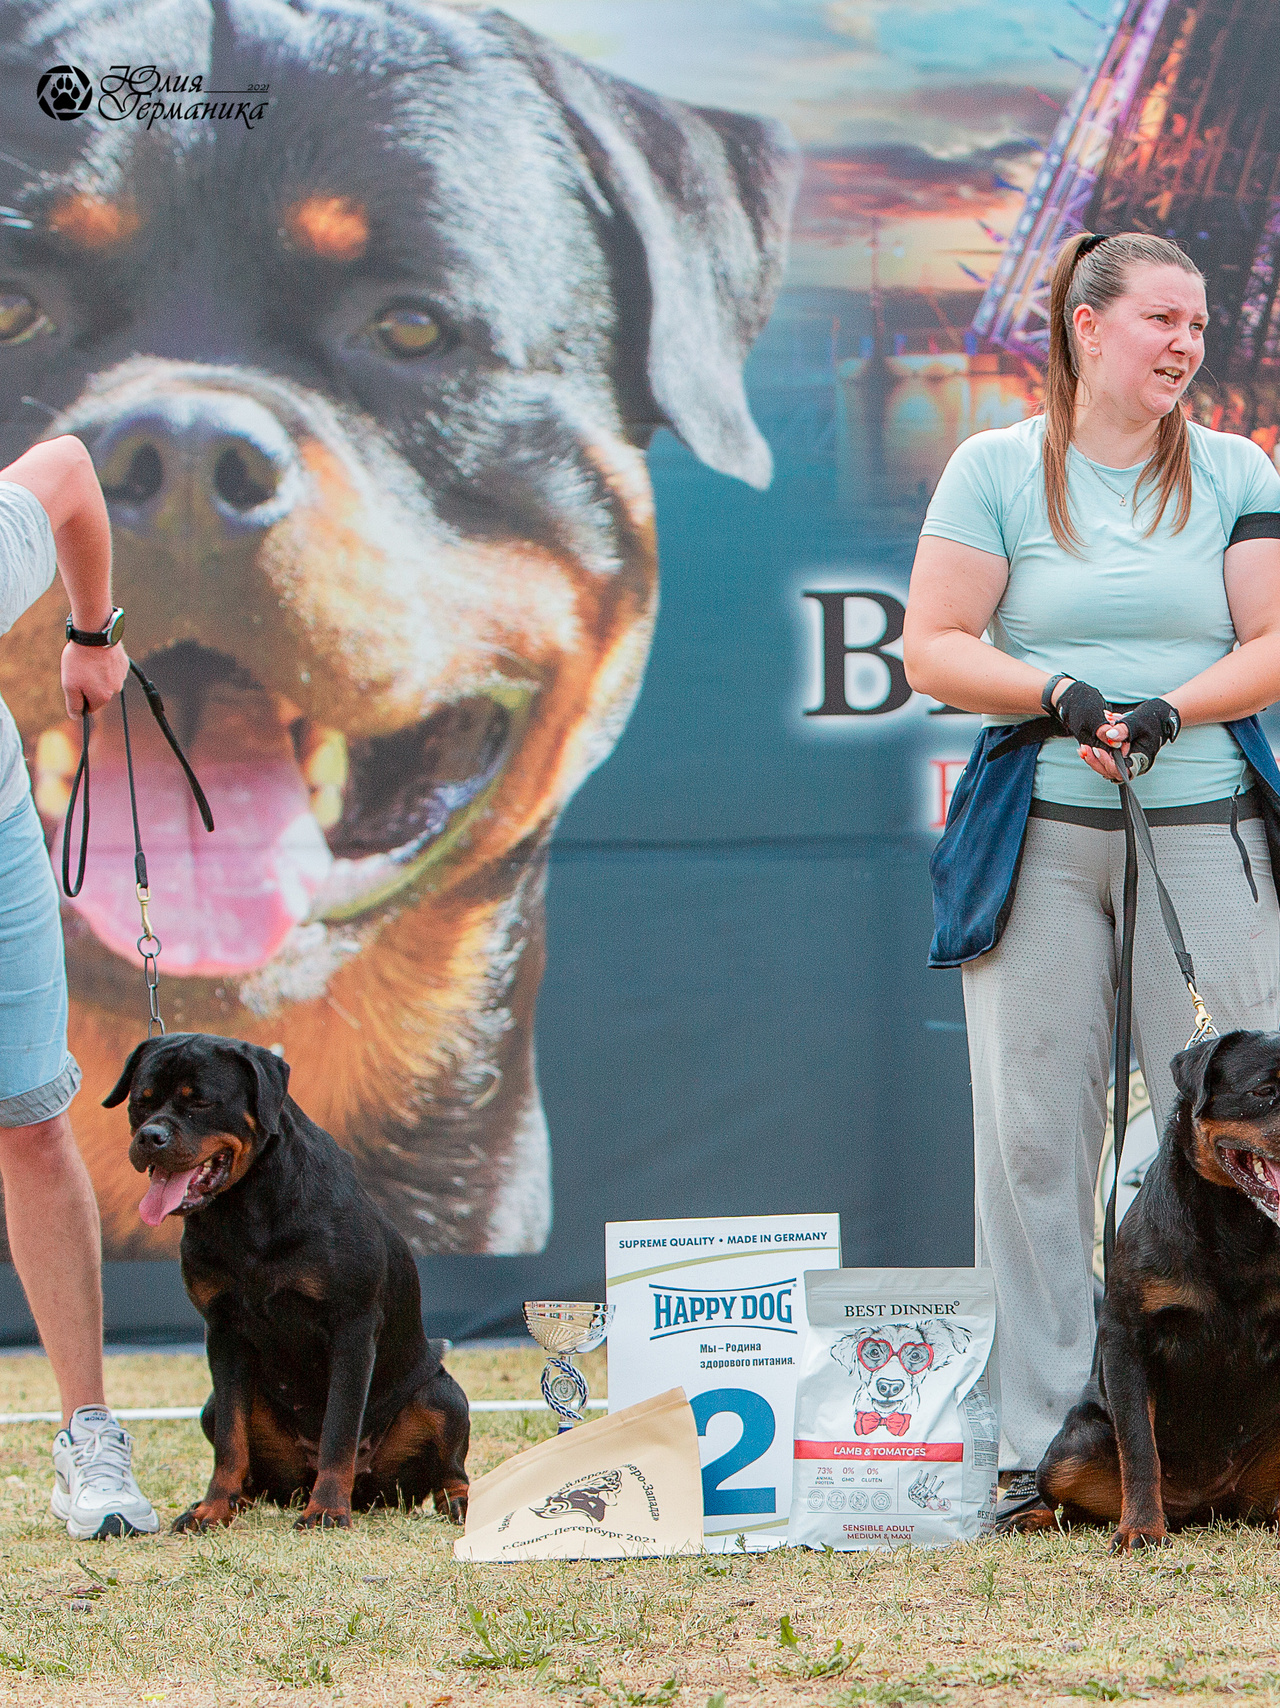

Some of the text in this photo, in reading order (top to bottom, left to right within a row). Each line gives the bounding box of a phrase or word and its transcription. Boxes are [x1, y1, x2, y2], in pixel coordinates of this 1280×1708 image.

[618, 1231, 828, 1249] SUPREME QUALITY MADE IN GERMANY
[652, 1288, 793, 1331] HAPPY DOG
[844, 1303, 957, 1317] BEST DINNER
[699, 1343, 717, 1354] Мы
[725, 1342, 762, 1354] Родина
[699, 1356, 796, 1370] здорового питания.
[688, 1387, 777, 1517] 2
[833, 1446, 926, 1457] LAMB & TOMATOES
[842, 1466, 855, 1475] 0%
[866, 1467, 879, 1475] 0%
[842, 1523, 915, 1533] SENSIBLE ADULT
[625, 1533, 657, 1544] 2021
[846, 1532, 882, 1541] MEDIUM
